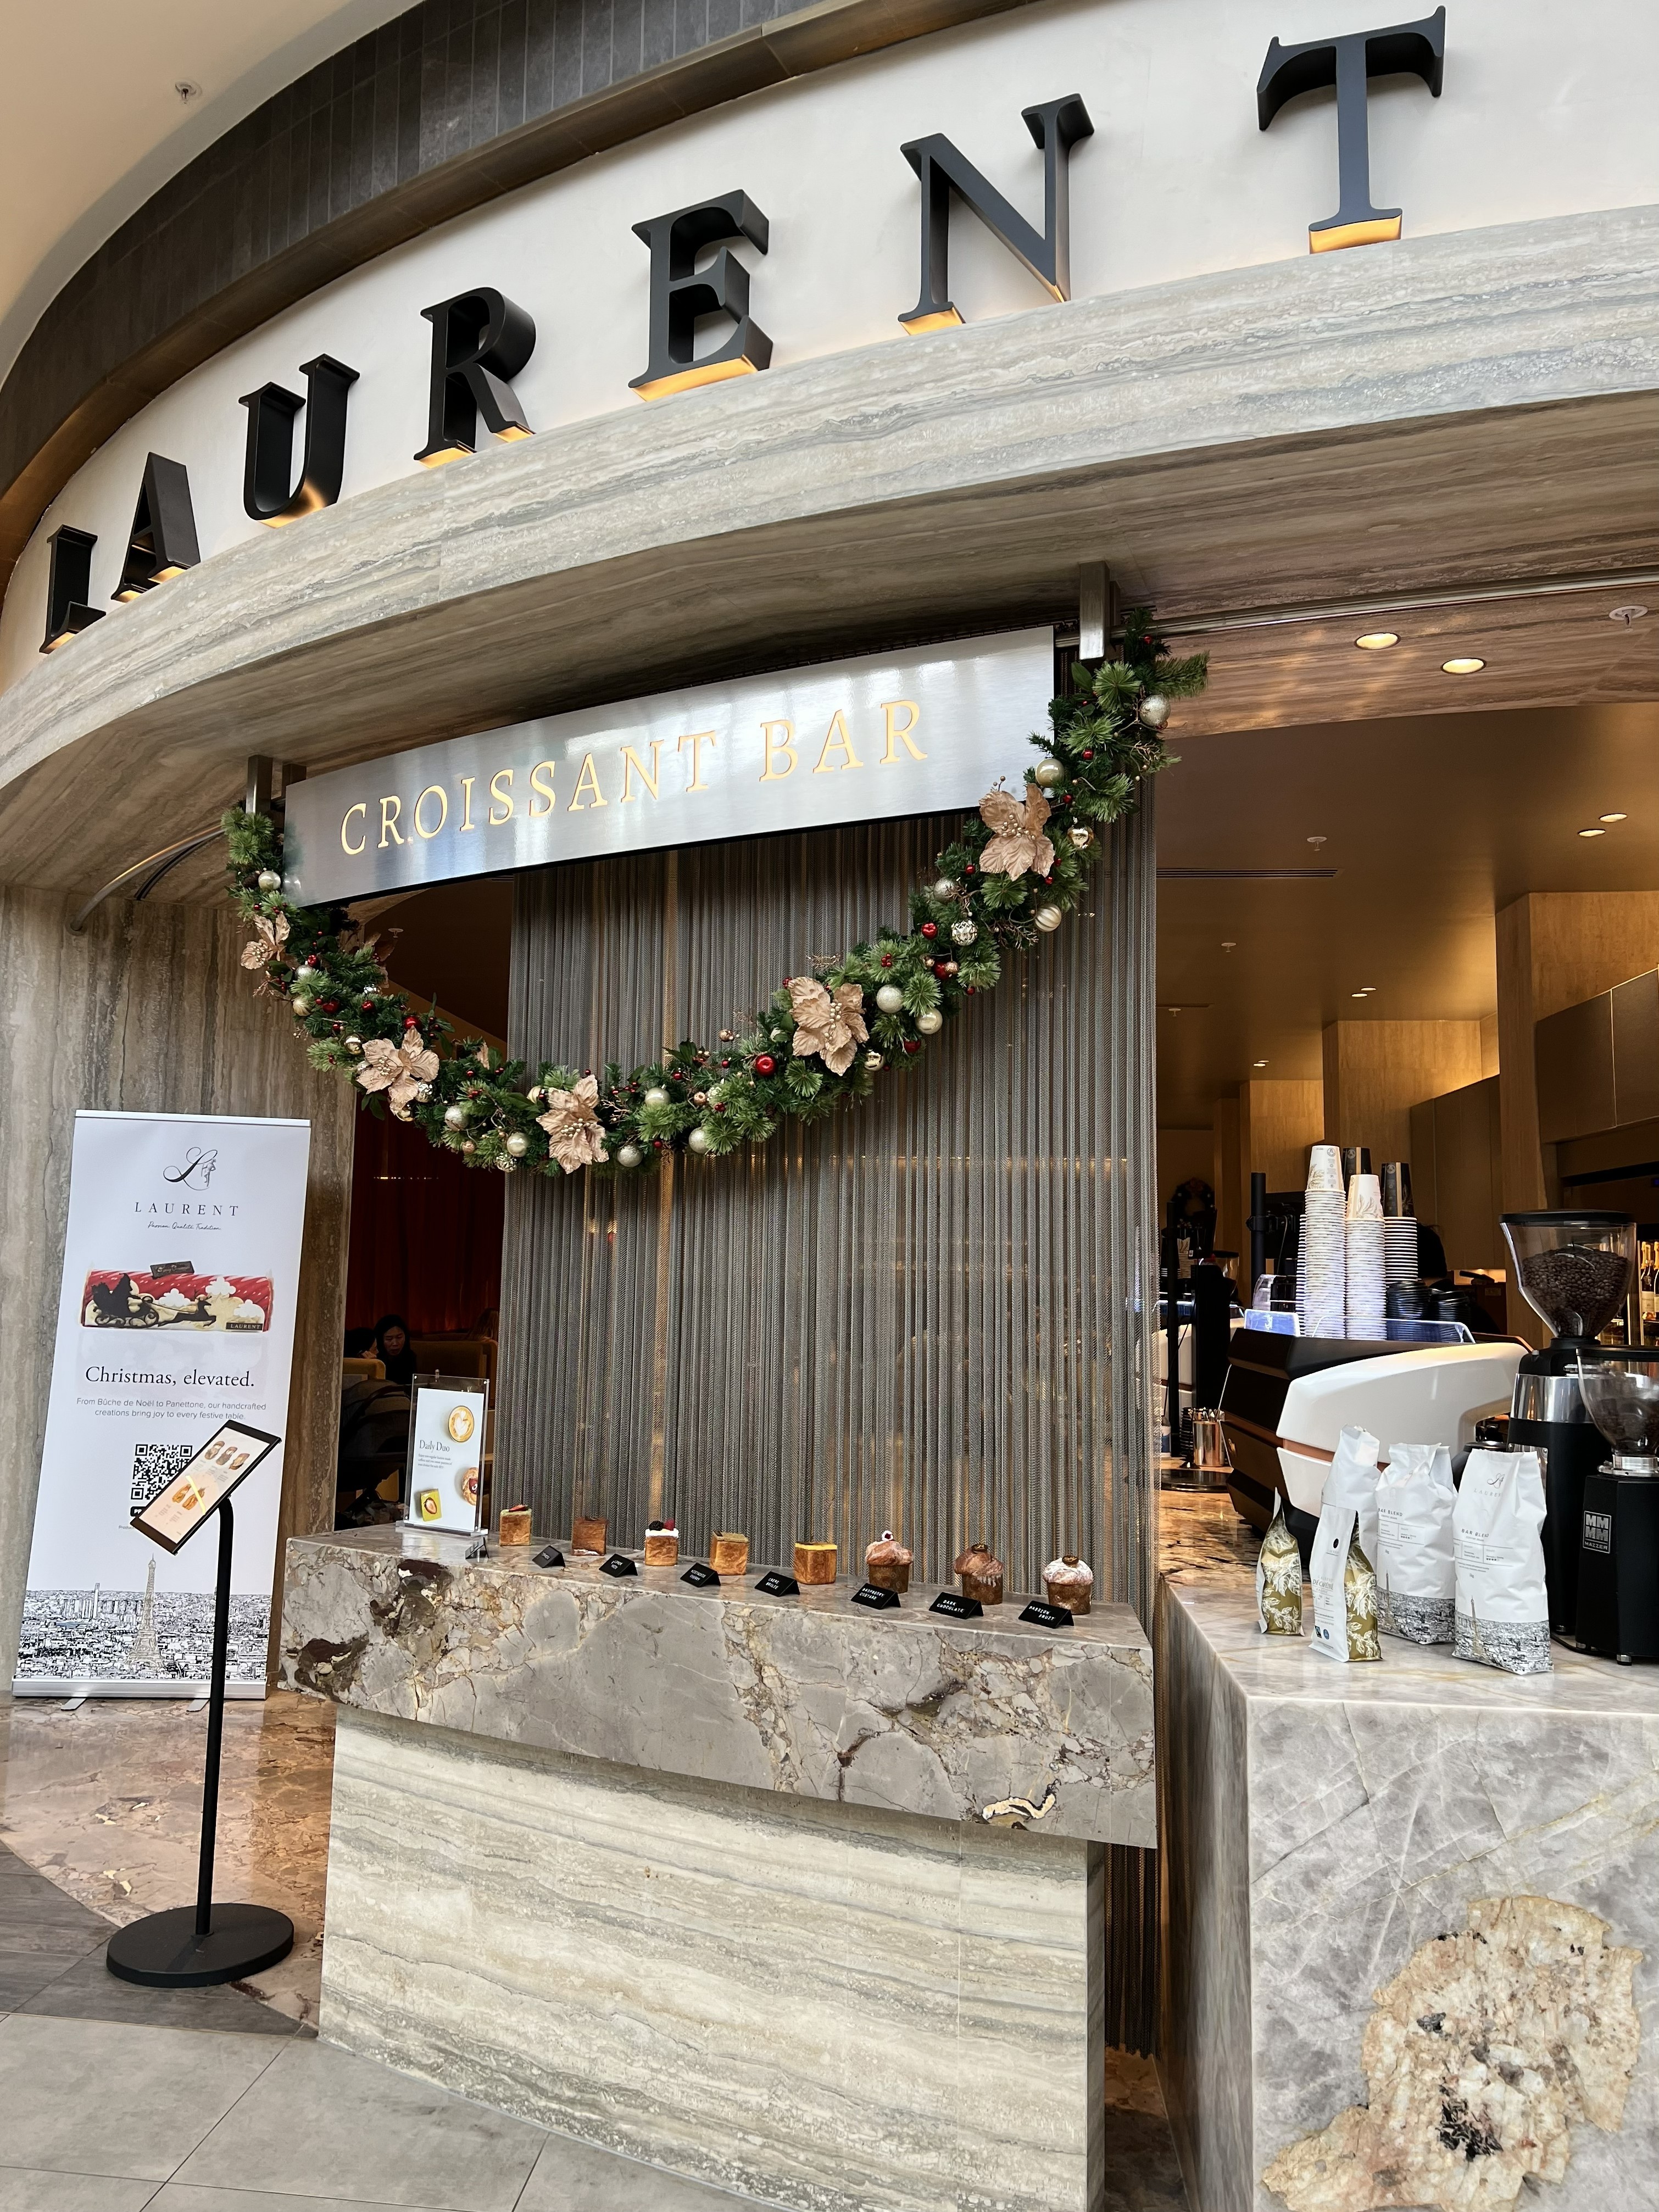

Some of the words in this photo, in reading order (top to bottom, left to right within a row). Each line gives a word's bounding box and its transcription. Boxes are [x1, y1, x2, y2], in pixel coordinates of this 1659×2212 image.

[39, 5, 1446, 654] LAURENT
[340, 730, 717, 856] CROISSANT
[759, 699, 928, 783] BAR
[135, 1202, 238, 1216] LAURENT
[86, 1366, 176, 1386] Christmas,
[183, 1369, 254, 1387] elevated.
[97, 1398, 121, 1406] Bûche
[165, 1400, 206, 1409] Panettone,
[222, 1402, 266, 1410] handcrafted
[131, 1409, 151, 1418] bring
[419, 1440, 435, 1453] Daily
[436, 1442, 450, 1452] Duo
[1584, 1541, 1608, 1550] MAZZER
[859, 1592, 877, 1600] CUSTARD
[862, 1587, 884, 1597] RASPBERRY
[937, 1603, 964, 1613] CHOCOLATE
[1028, 1606, 1050, 1615] PASSION
